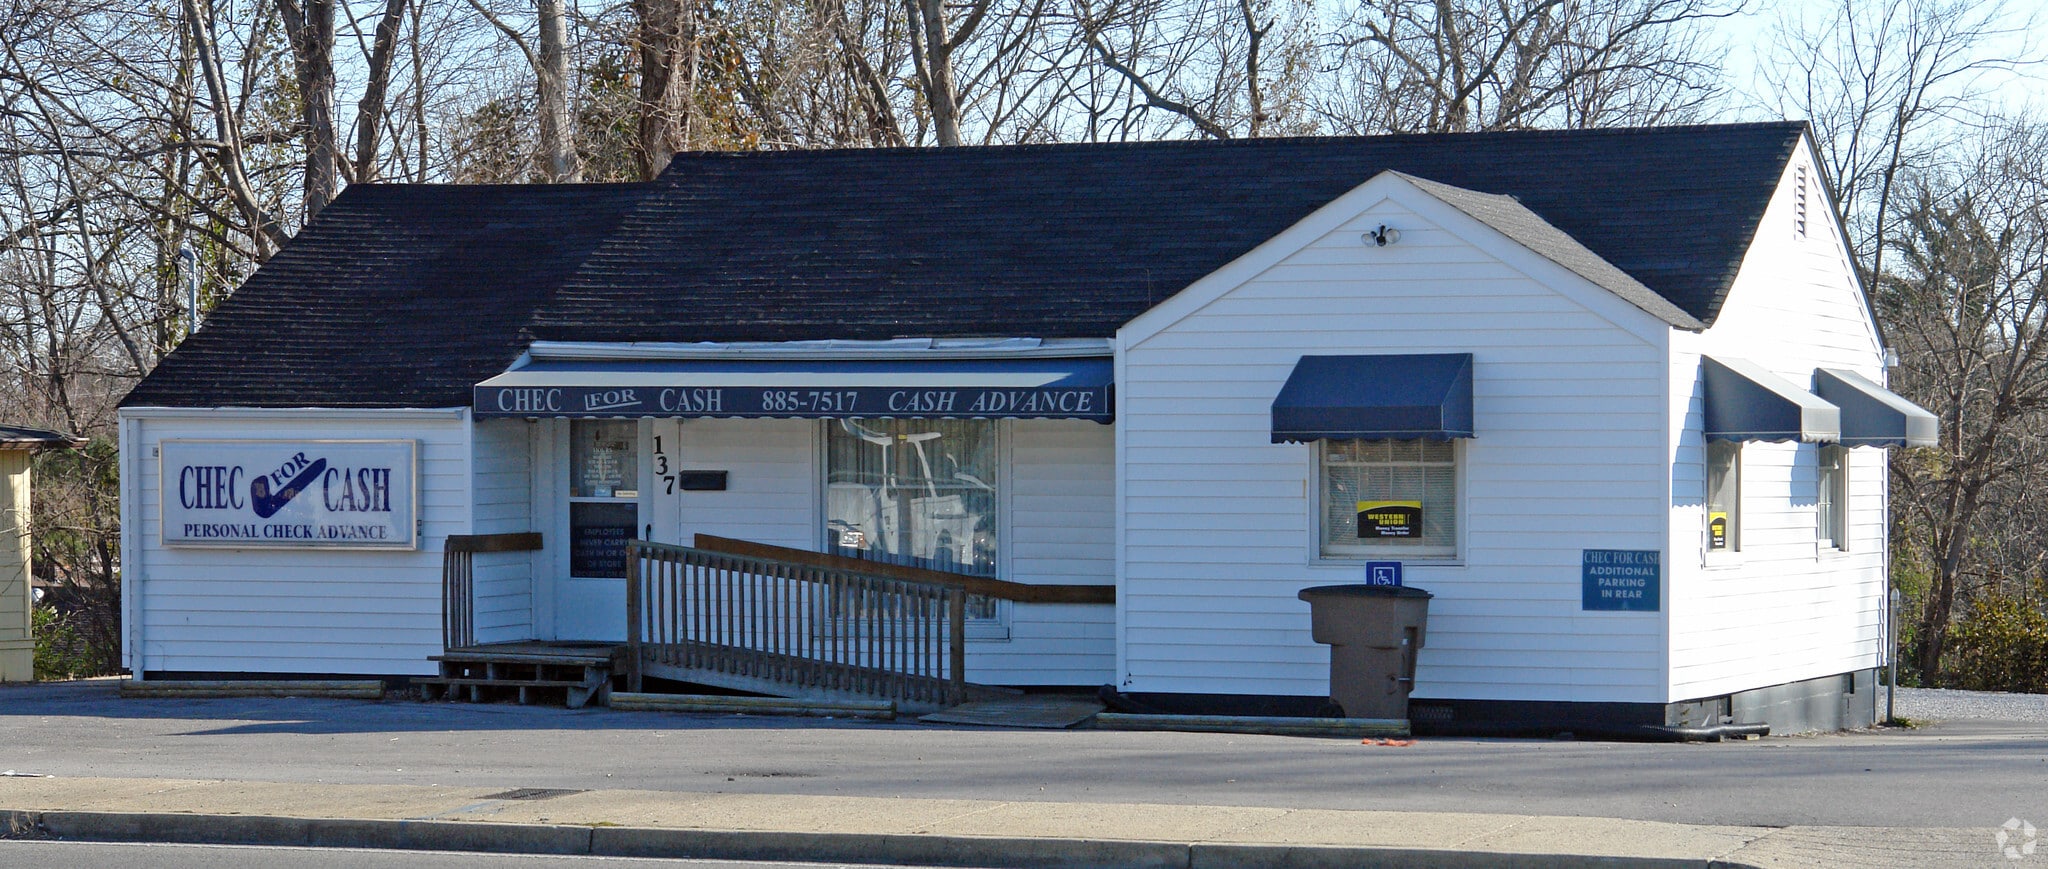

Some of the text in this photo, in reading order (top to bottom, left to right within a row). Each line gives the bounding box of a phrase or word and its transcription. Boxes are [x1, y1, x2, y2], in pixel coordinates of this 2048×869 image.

[498, 388, 1094, 411] CHEC FOR CASH 885-7517 CASH ADVANCE
[179, 451, 391, 512] CHEC FOR CASH
[184, 523, 387, 539] PERSONAL CHECK ADVANCE
[1584, 551, 1611, 564] CHEC
[1613, 551, 1633, 564] FOR
[1590, 566, 1655, 576] ADDITIONAL
[1598, 578, 1646, 587] PARKING
[1602, 589, 1642, 599] IN REAR
